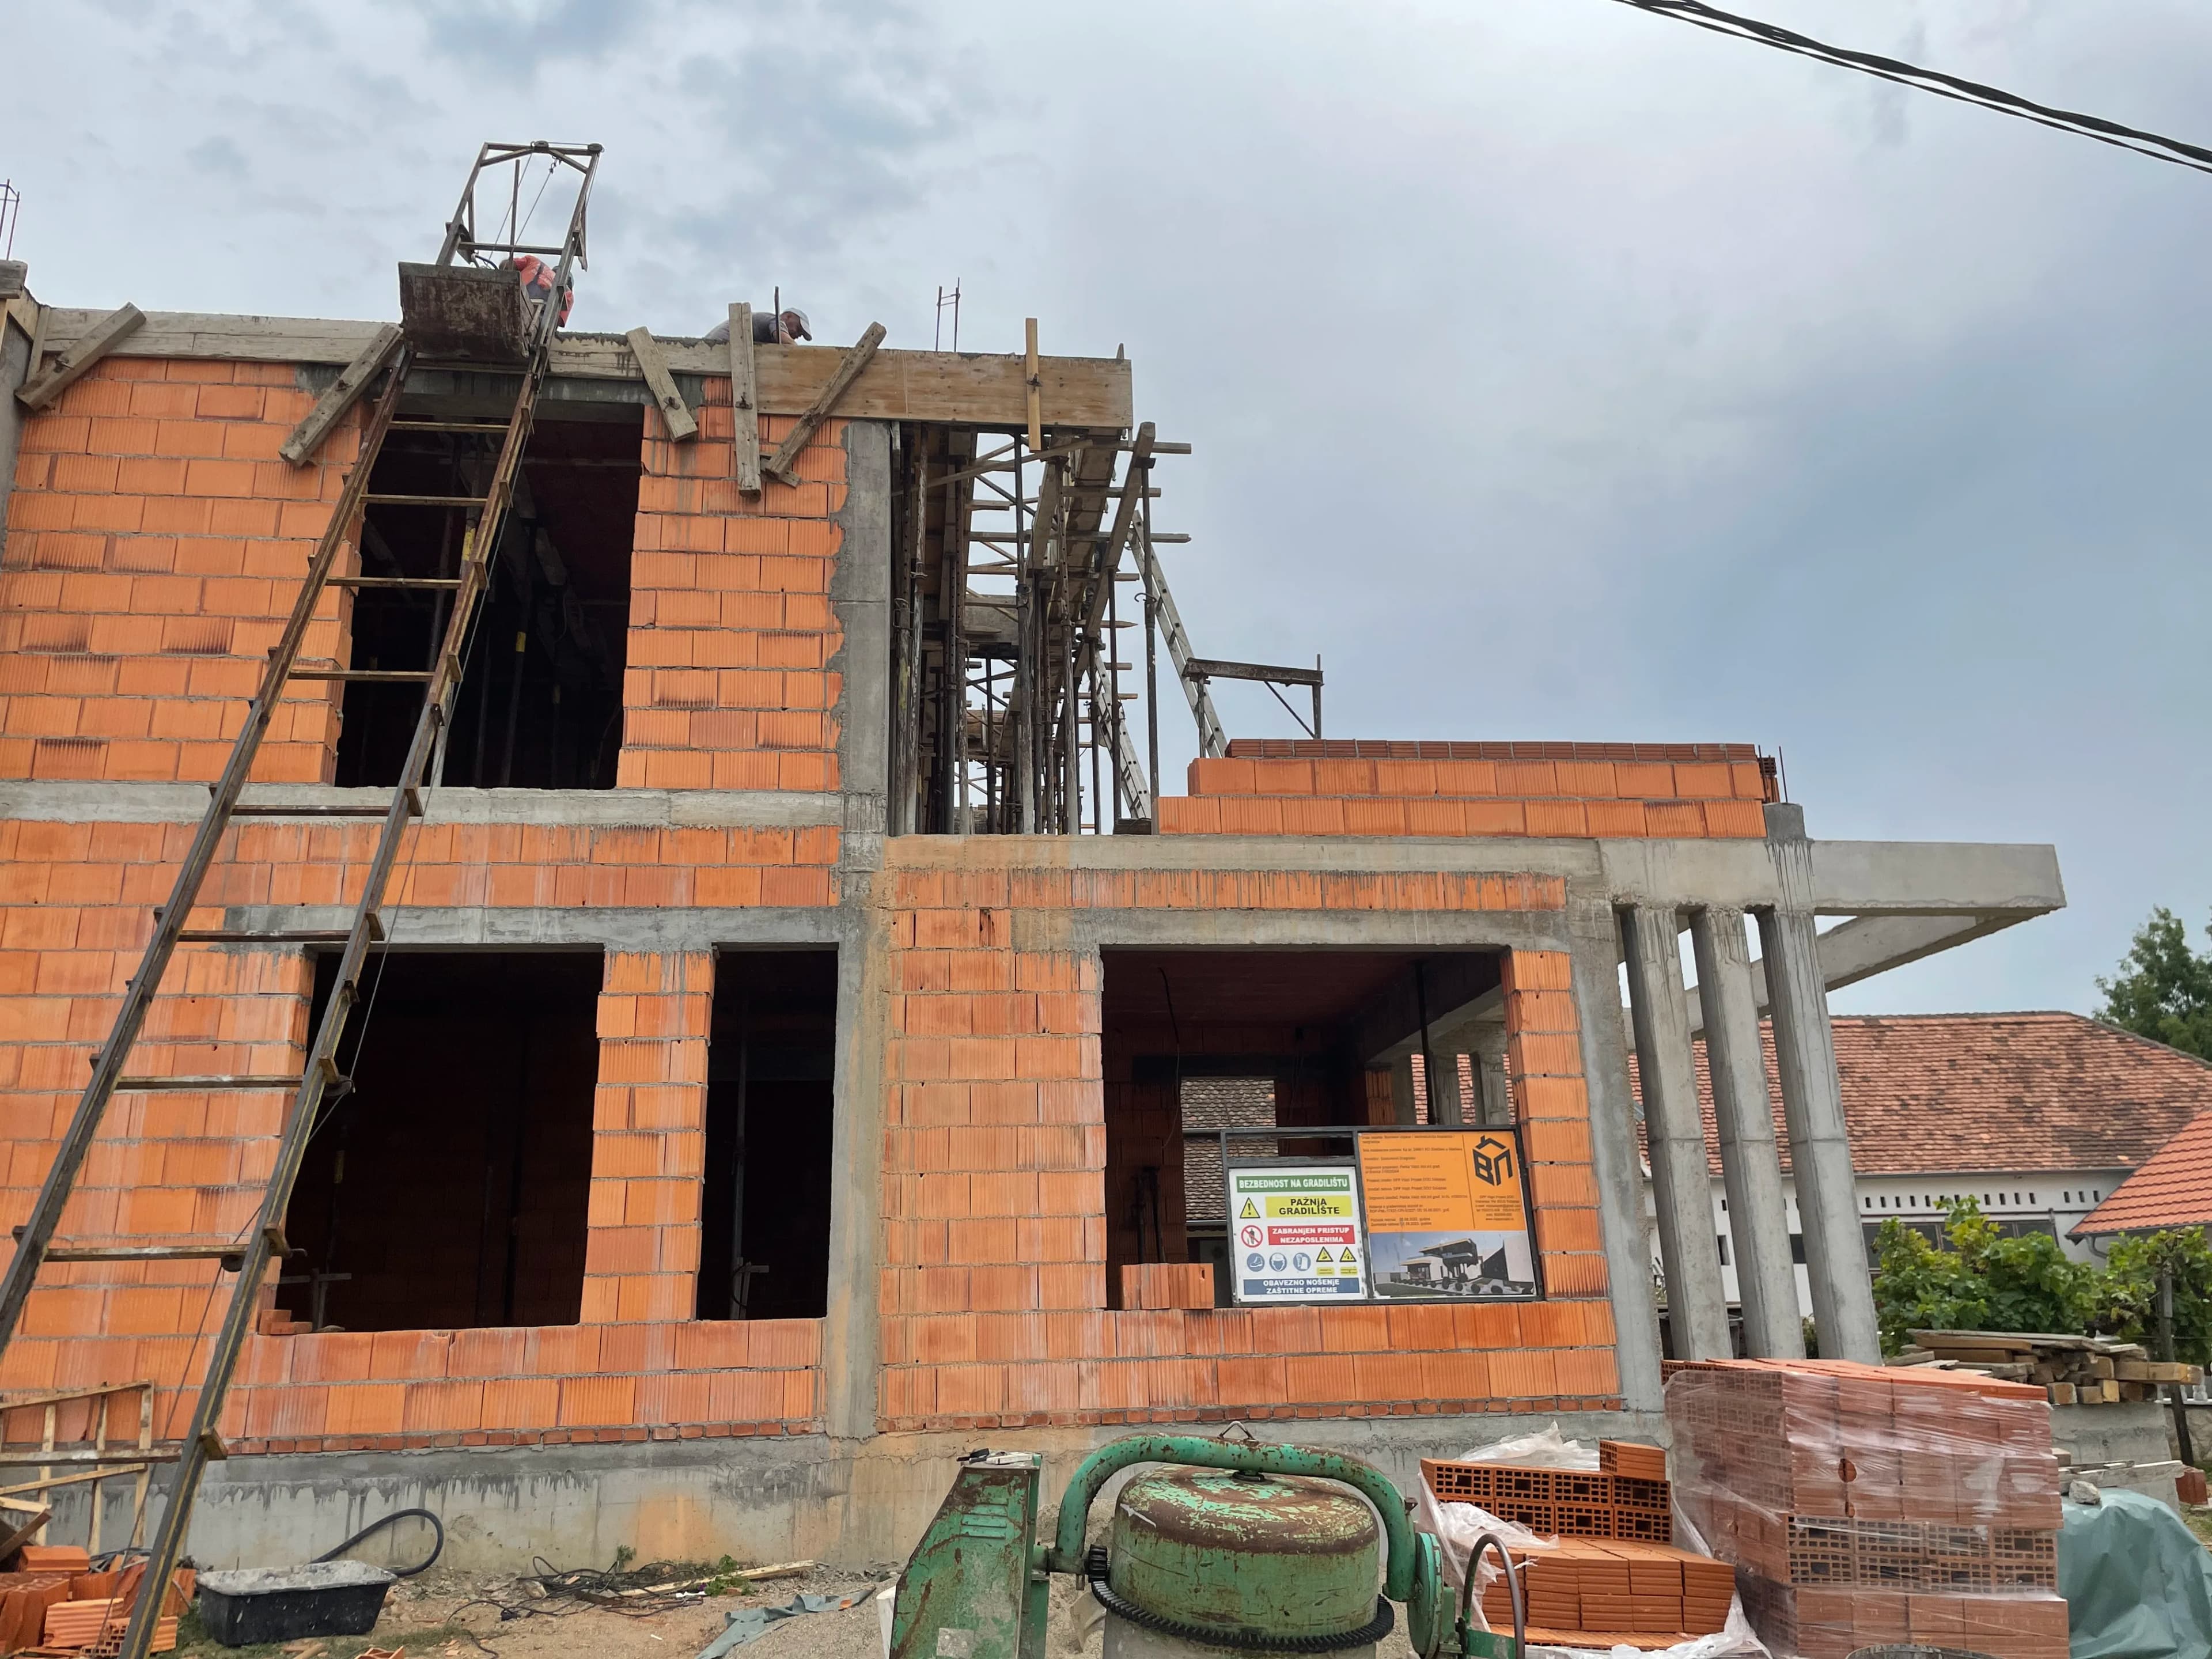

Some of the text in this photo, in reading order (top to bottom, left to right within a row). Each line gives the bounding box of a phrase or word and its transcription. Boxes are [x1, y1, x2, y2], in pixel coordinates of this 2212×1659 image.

[1238, 1177, 1347, 1188] BEZBEDNOST NA GRADILIŠTU
[1279, 1206, 1340, 1215] GRADILIŠTE
